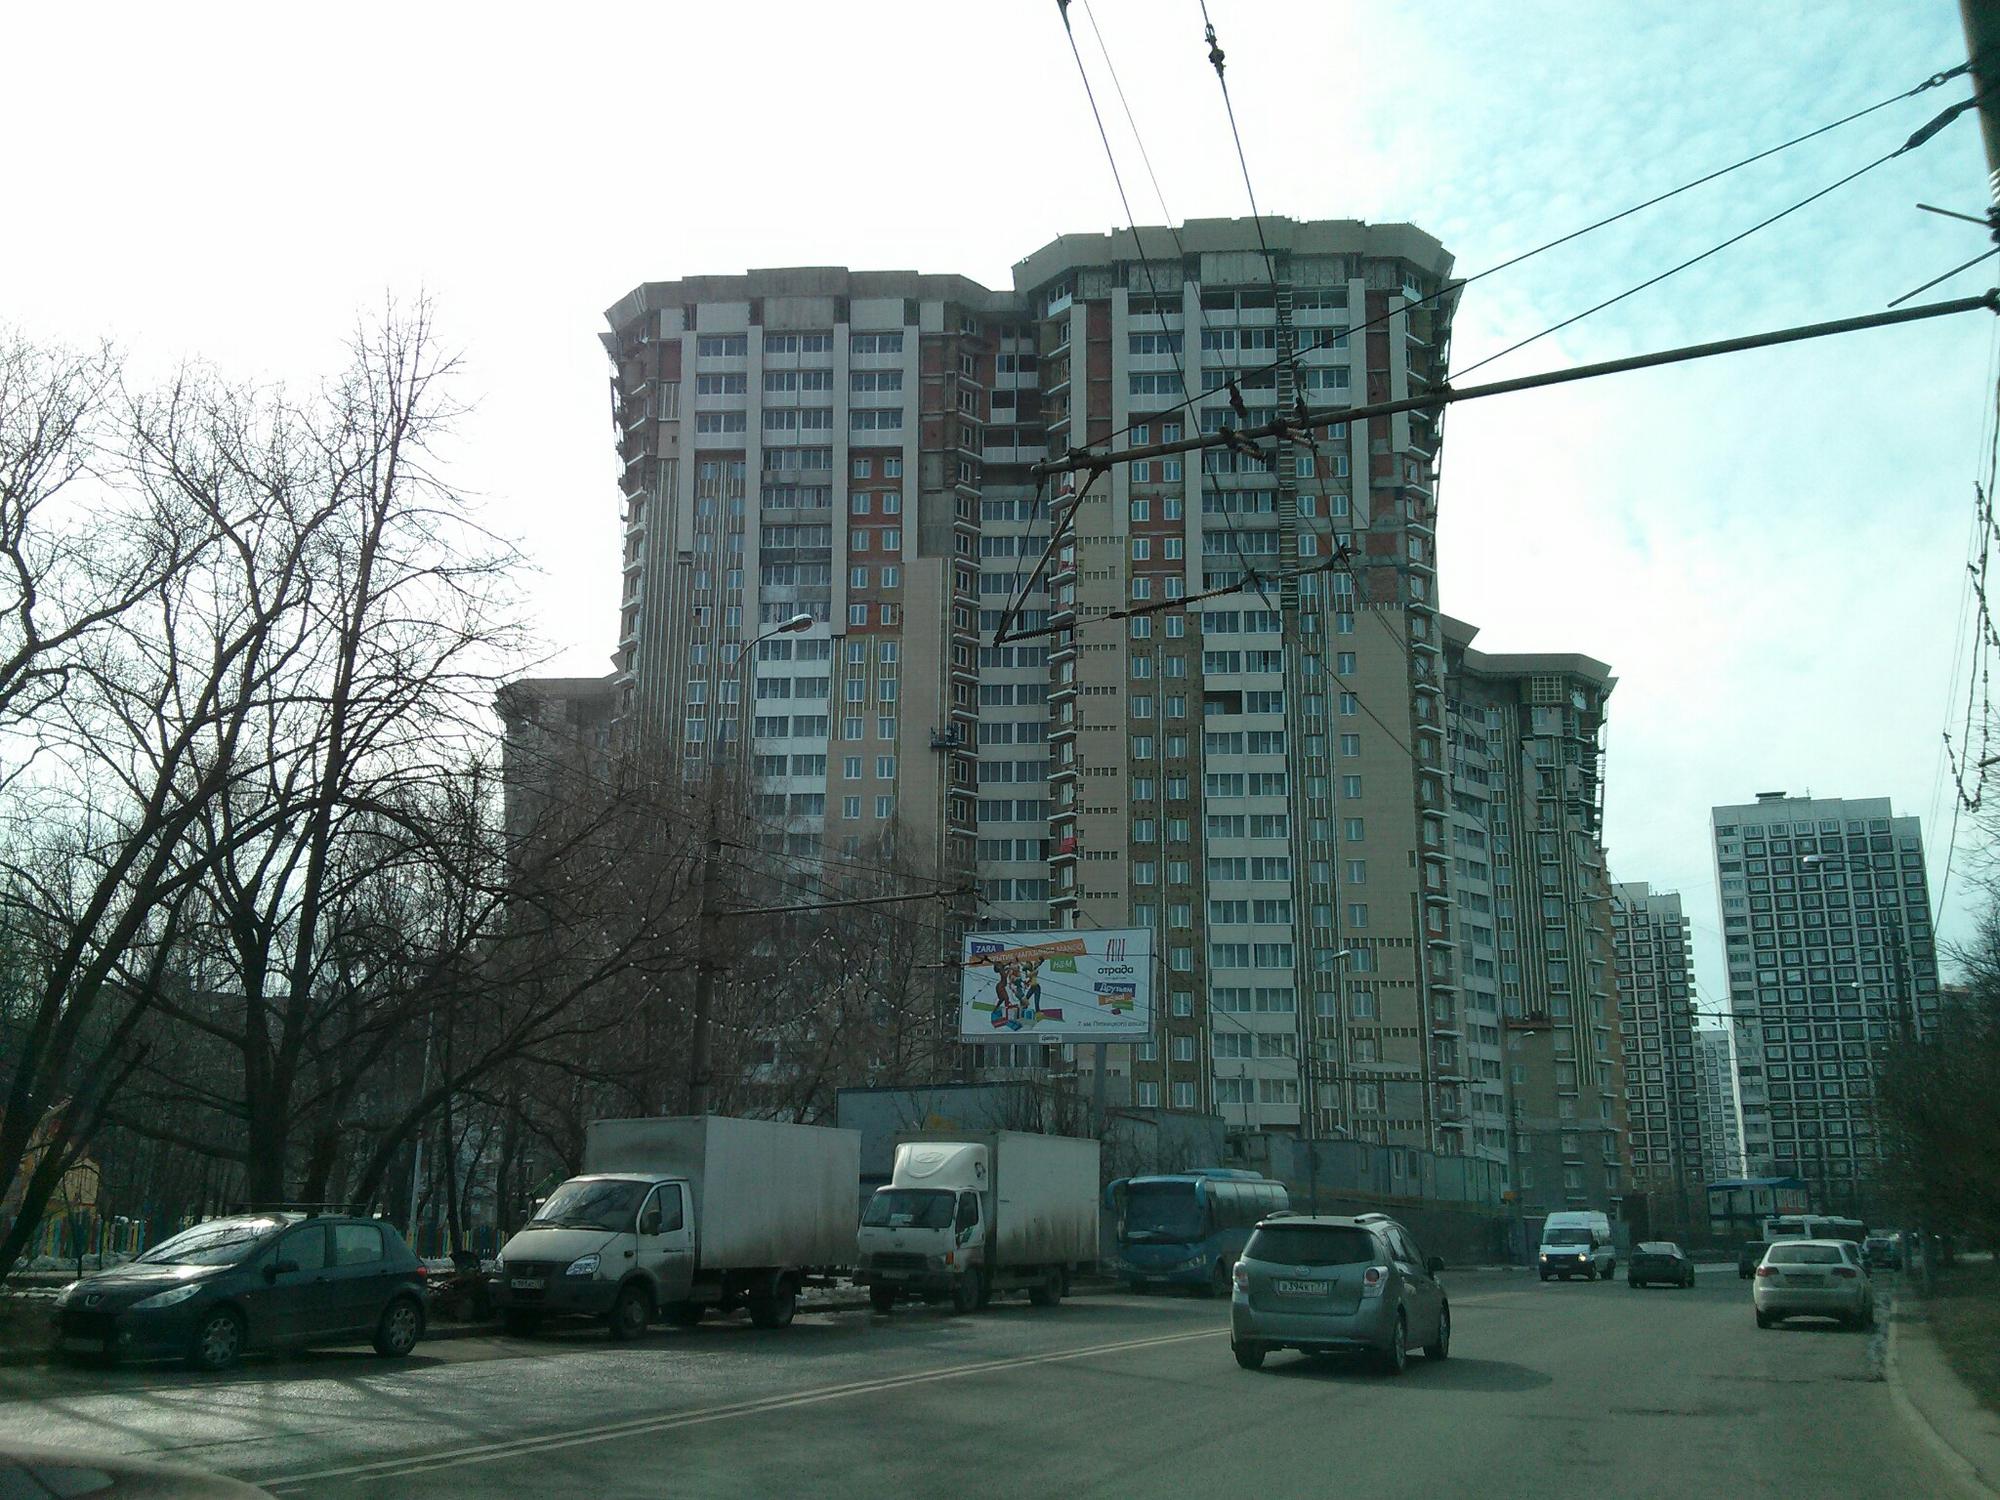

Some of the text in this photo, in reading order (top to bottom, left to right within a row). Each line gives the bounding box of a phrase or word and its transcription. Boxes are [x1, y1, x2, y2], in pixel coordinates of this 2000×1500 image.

[976, 945, 996, 953] ZARA
[1053, 960, 1073, 969] H&M
[1097, 964, 1134, 976] отрада
